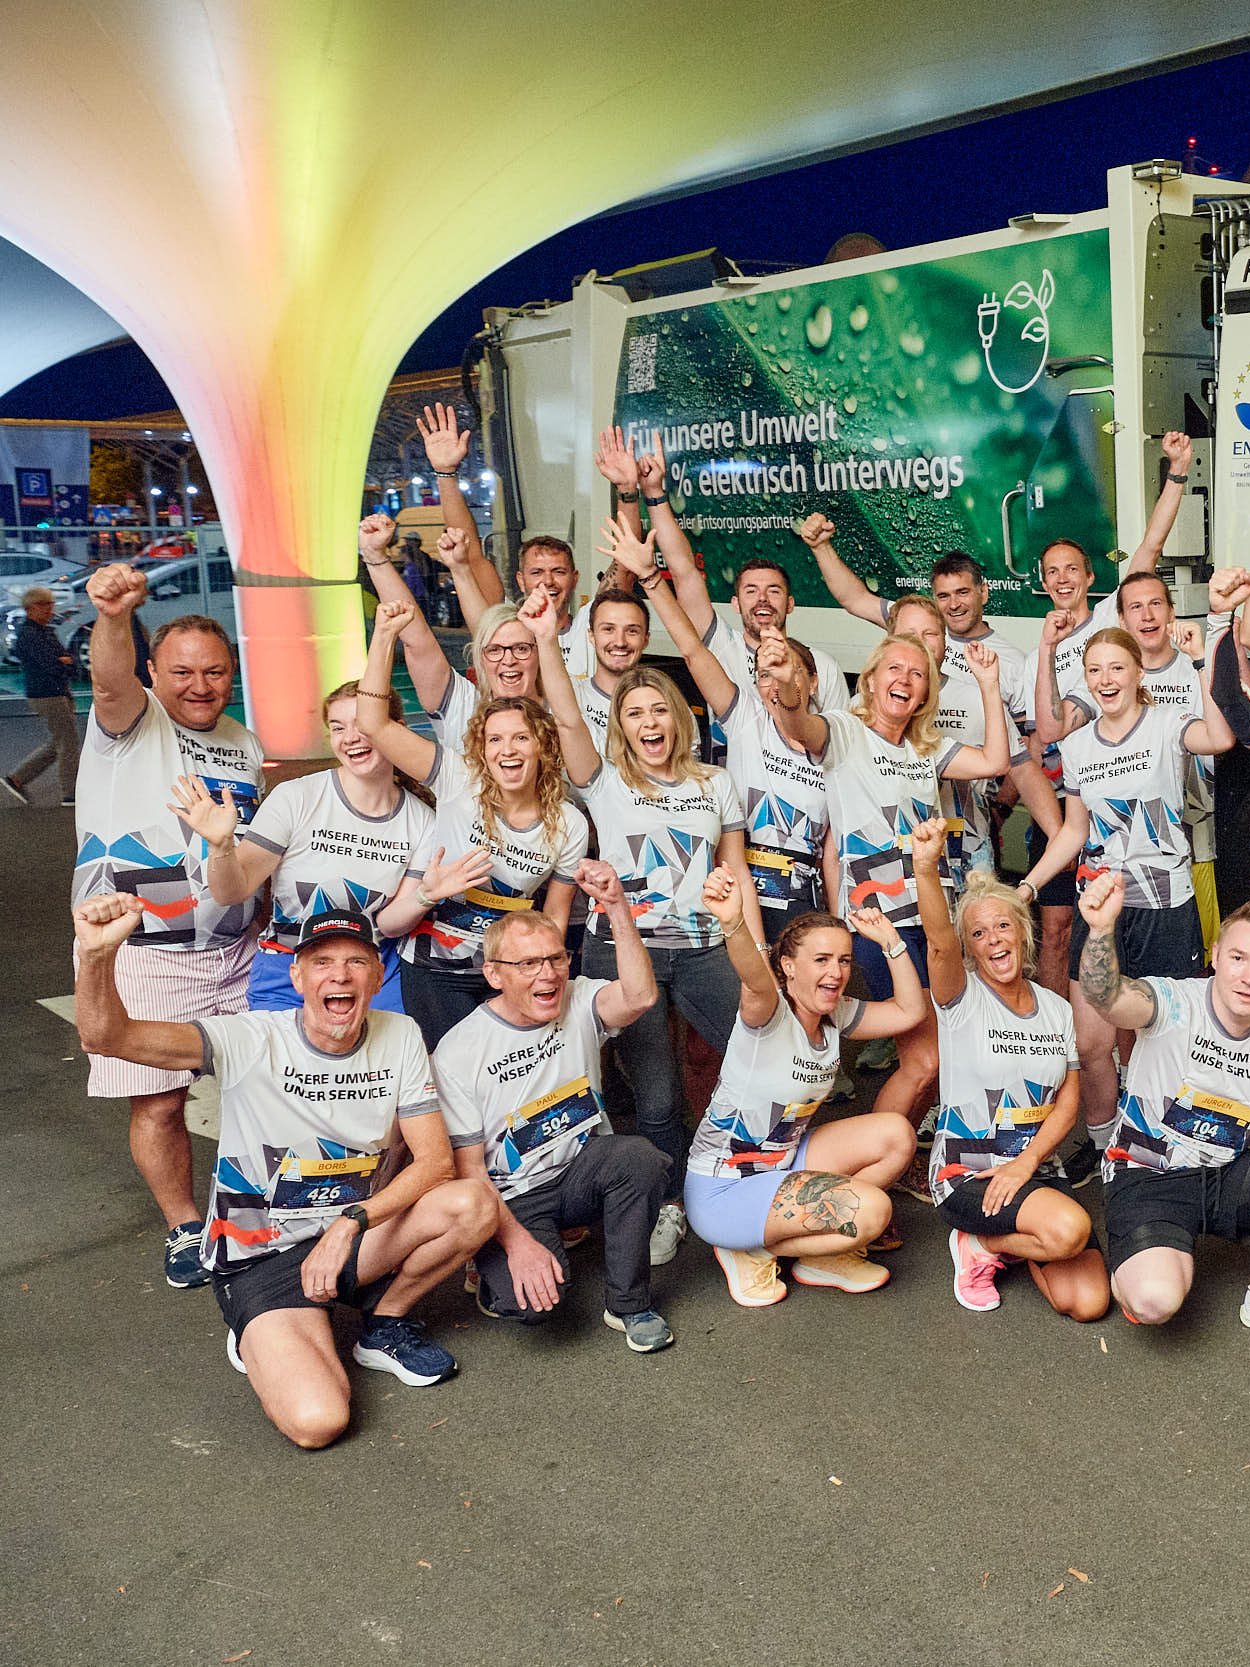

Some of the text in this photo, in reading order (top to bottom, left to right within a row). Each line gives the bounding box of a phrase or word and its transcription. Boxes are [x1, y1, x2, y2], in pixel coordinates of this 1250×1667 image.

[664, 424, 734, 451] unsere
[741, 401, 839, 446] Umwelt
[671, 453, 965, 500] % elektrisch unterwegs
[698, 514, 794, 533] Entsorgungspartner
[1151, 684, 1192, 693] UMWELT.
[1153, 695, 1190, 705] ERVICE.
[1110, 749, 1152, 766] UMWELT.
[1108, 761, 1151, 778] SERVICE.
[311, 842, 352, 857] UNSER
[992, 1044, 1026, 1055] UNSER
[334, 1068, 394, 1085] UMWELT.
[791, 1070, 819, 1084] UNSER
[329, 1086, 392, 1101] SERVICE.
[536, 1092, 558, 1107] PAUL
[1202, 1095, 1232, 1110] JÜRGEN
[541, 1111, 570, 1137] 504
[1192, 1120, 1219, 1138] 104
[318, 1162, 347, 1171] BORIS
[307, 1185, 341, 1201] 426
